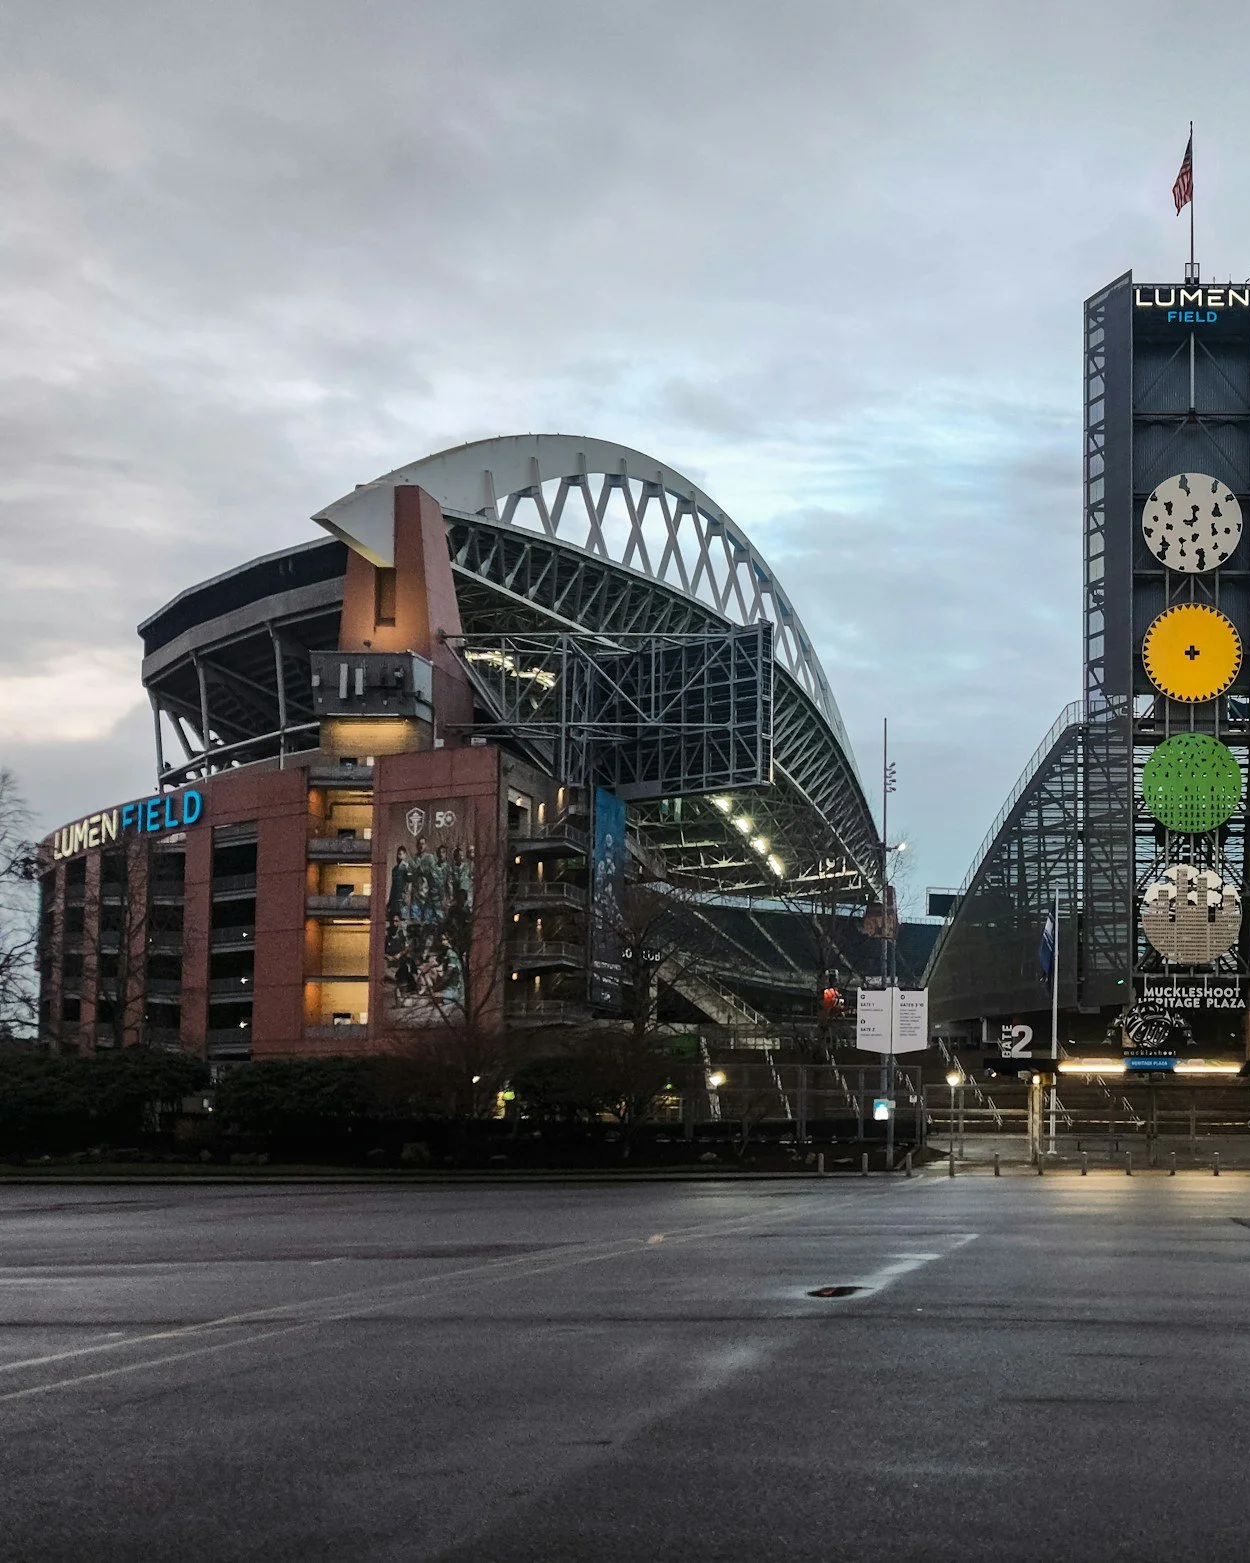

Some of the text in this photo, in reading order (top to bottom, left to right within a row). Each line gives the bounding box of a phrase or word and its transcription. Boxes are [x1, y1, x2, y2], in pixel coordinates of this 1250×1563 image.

[1136, 288, 1249, 307] LUMEN
[1167, 311, 1217, 323] FIELD
[53, 789, 204, 860] LUMEN FIELD
[435, 810, 457, 828] 50
[1144, 987, 1241, 998] MUCKLESHOOT
[1206, 998, 1246, 1009] PLAZA
[1001, 1024, 1033, 1059] GATE 2
